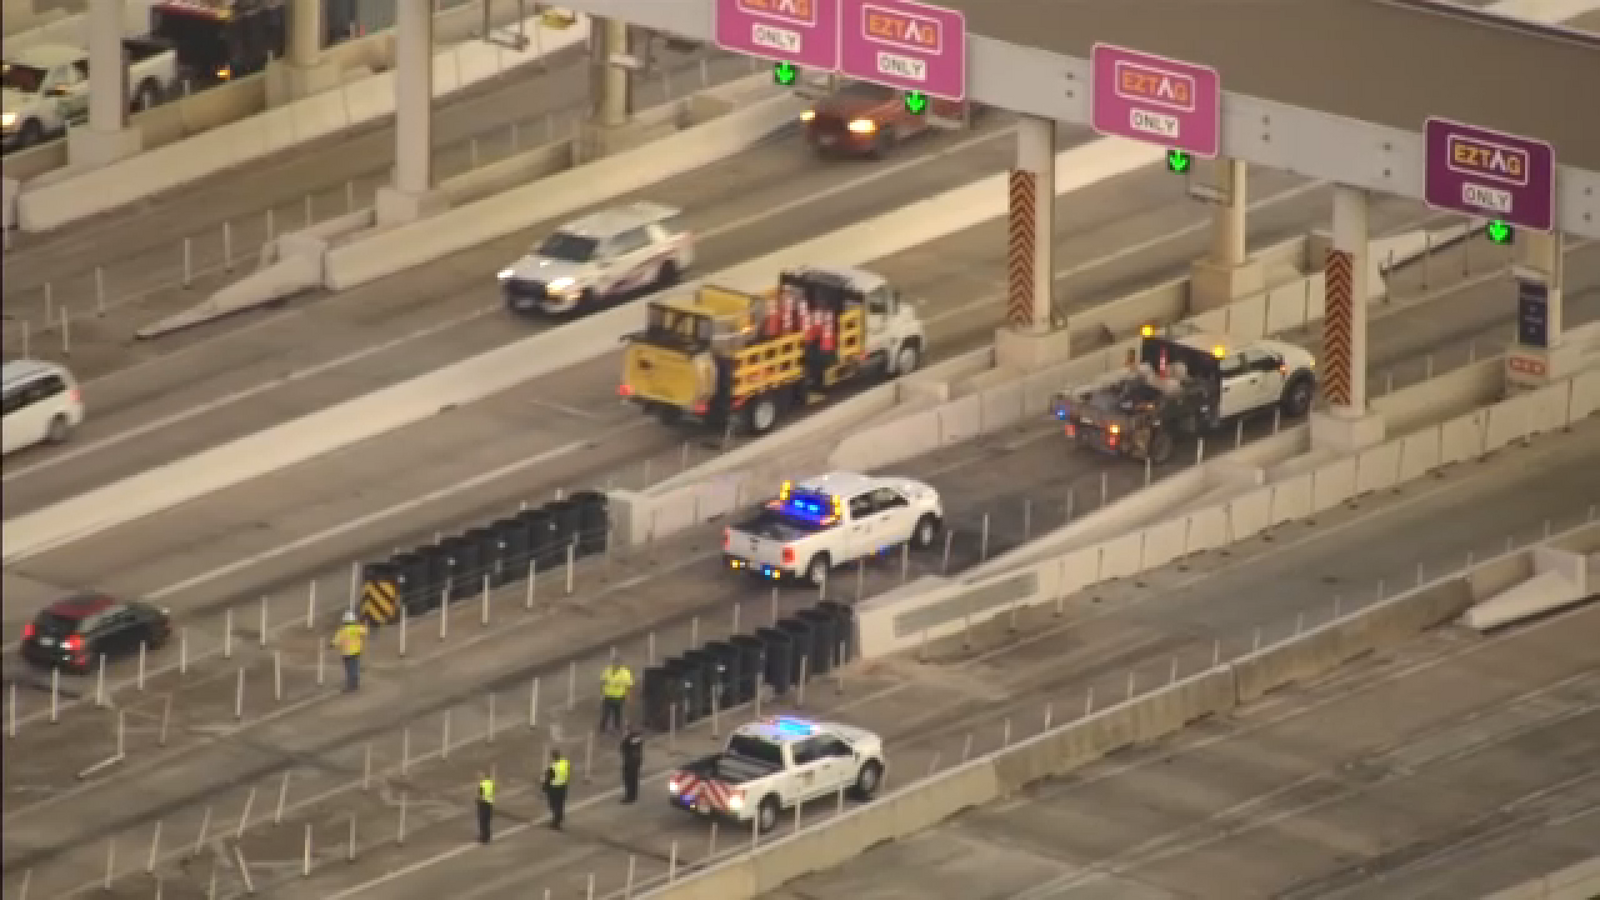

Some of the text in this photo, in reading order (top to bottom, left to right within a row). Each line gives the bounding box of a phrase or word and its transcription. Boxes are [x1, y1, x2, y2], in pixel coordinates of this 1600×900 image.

[755, 26, 797, 47] ONLY
[880, 54, 923, 76] ONLY
[1134, 111, 1175, 133] ONLY
[1465, 187, 1508, 208] ONLY
